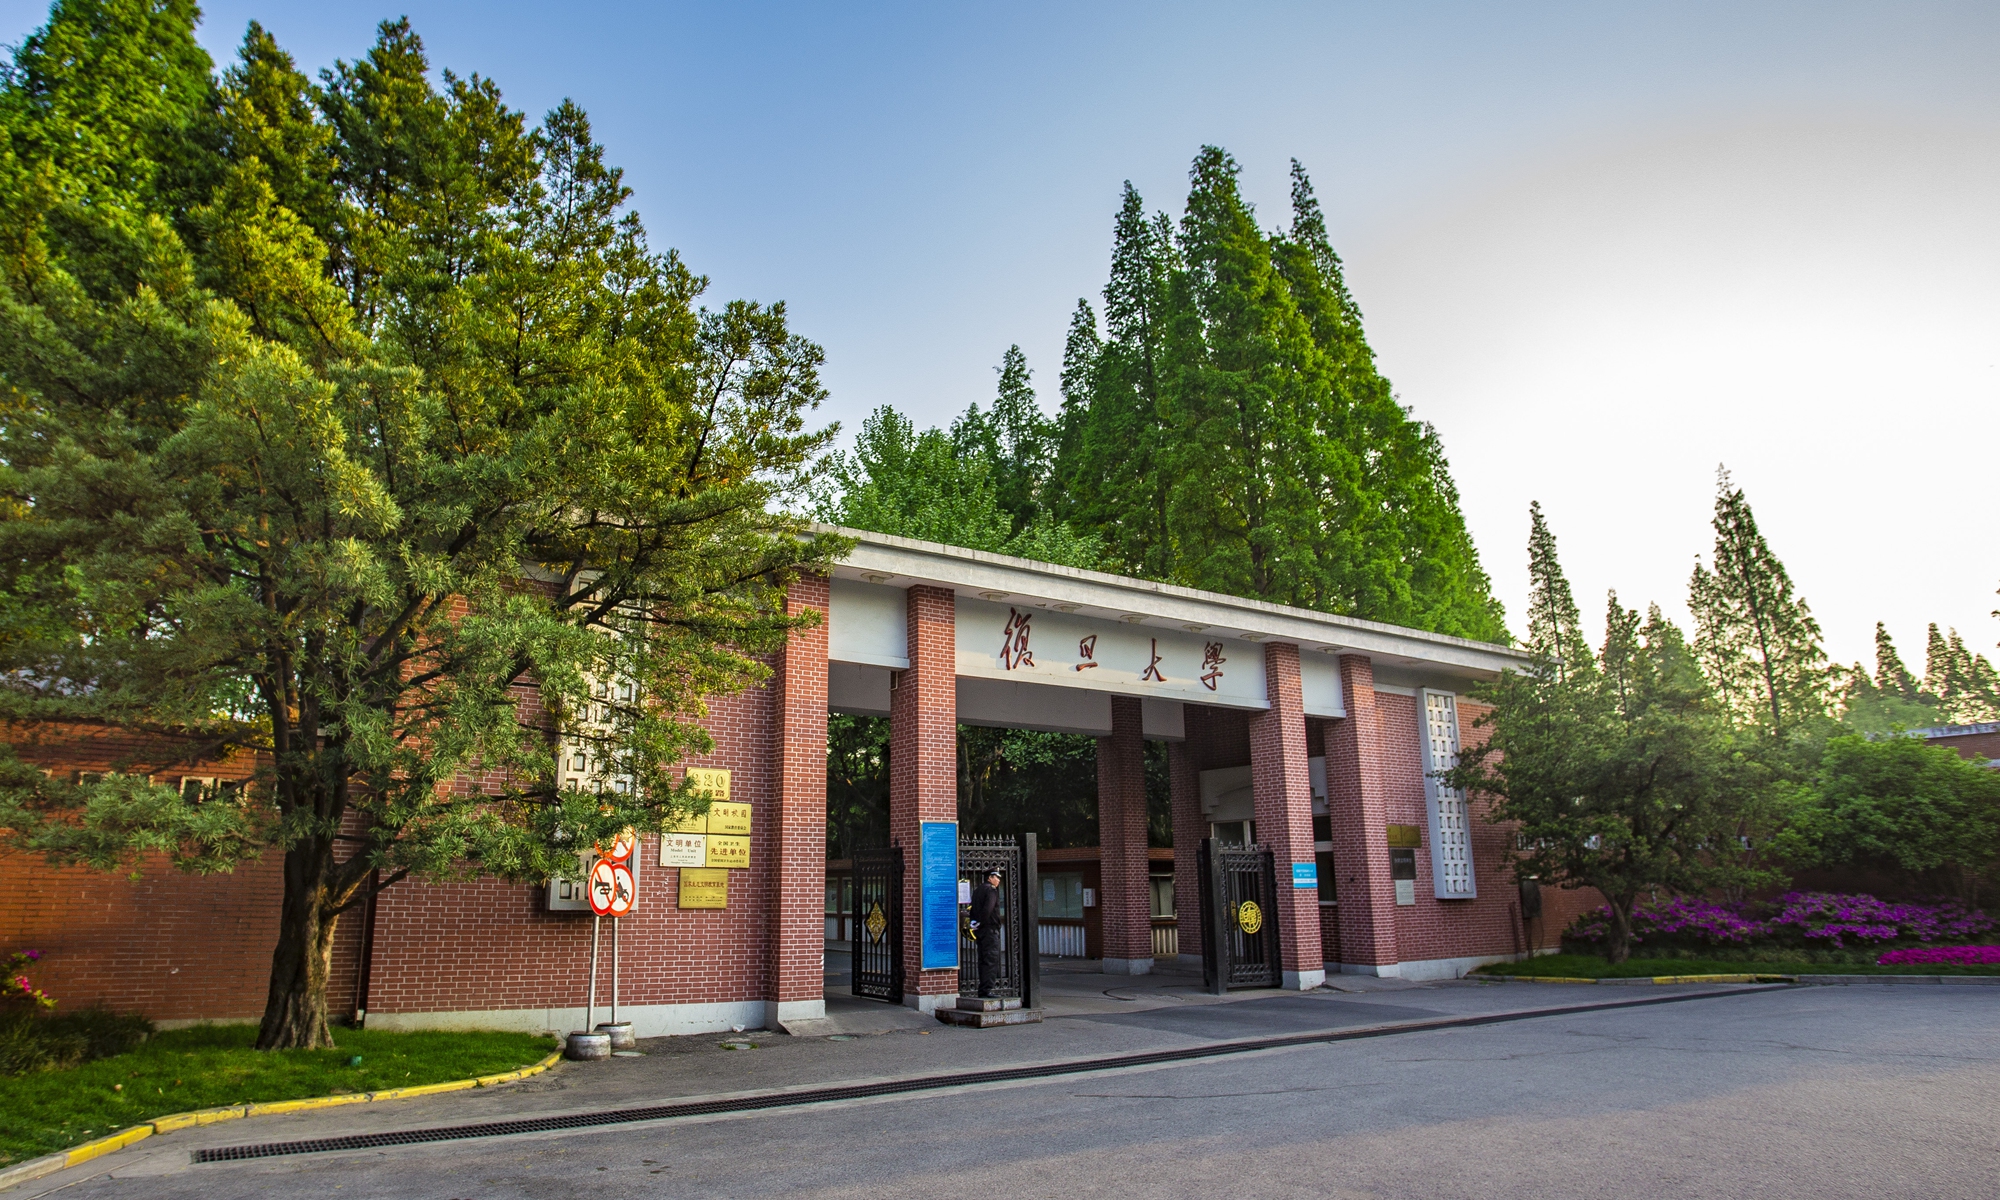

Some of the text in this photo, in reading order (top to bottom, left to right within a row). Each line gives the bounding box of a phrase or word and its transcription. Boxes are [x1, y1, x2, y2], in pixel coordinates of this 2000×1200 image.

[1000, 607, 1227, 691] 復旦大學
[692, 772, 725, 788] 220
[666, 839, 702, 848] 文明单位
[710, 847, 746, 856] 先进单位
